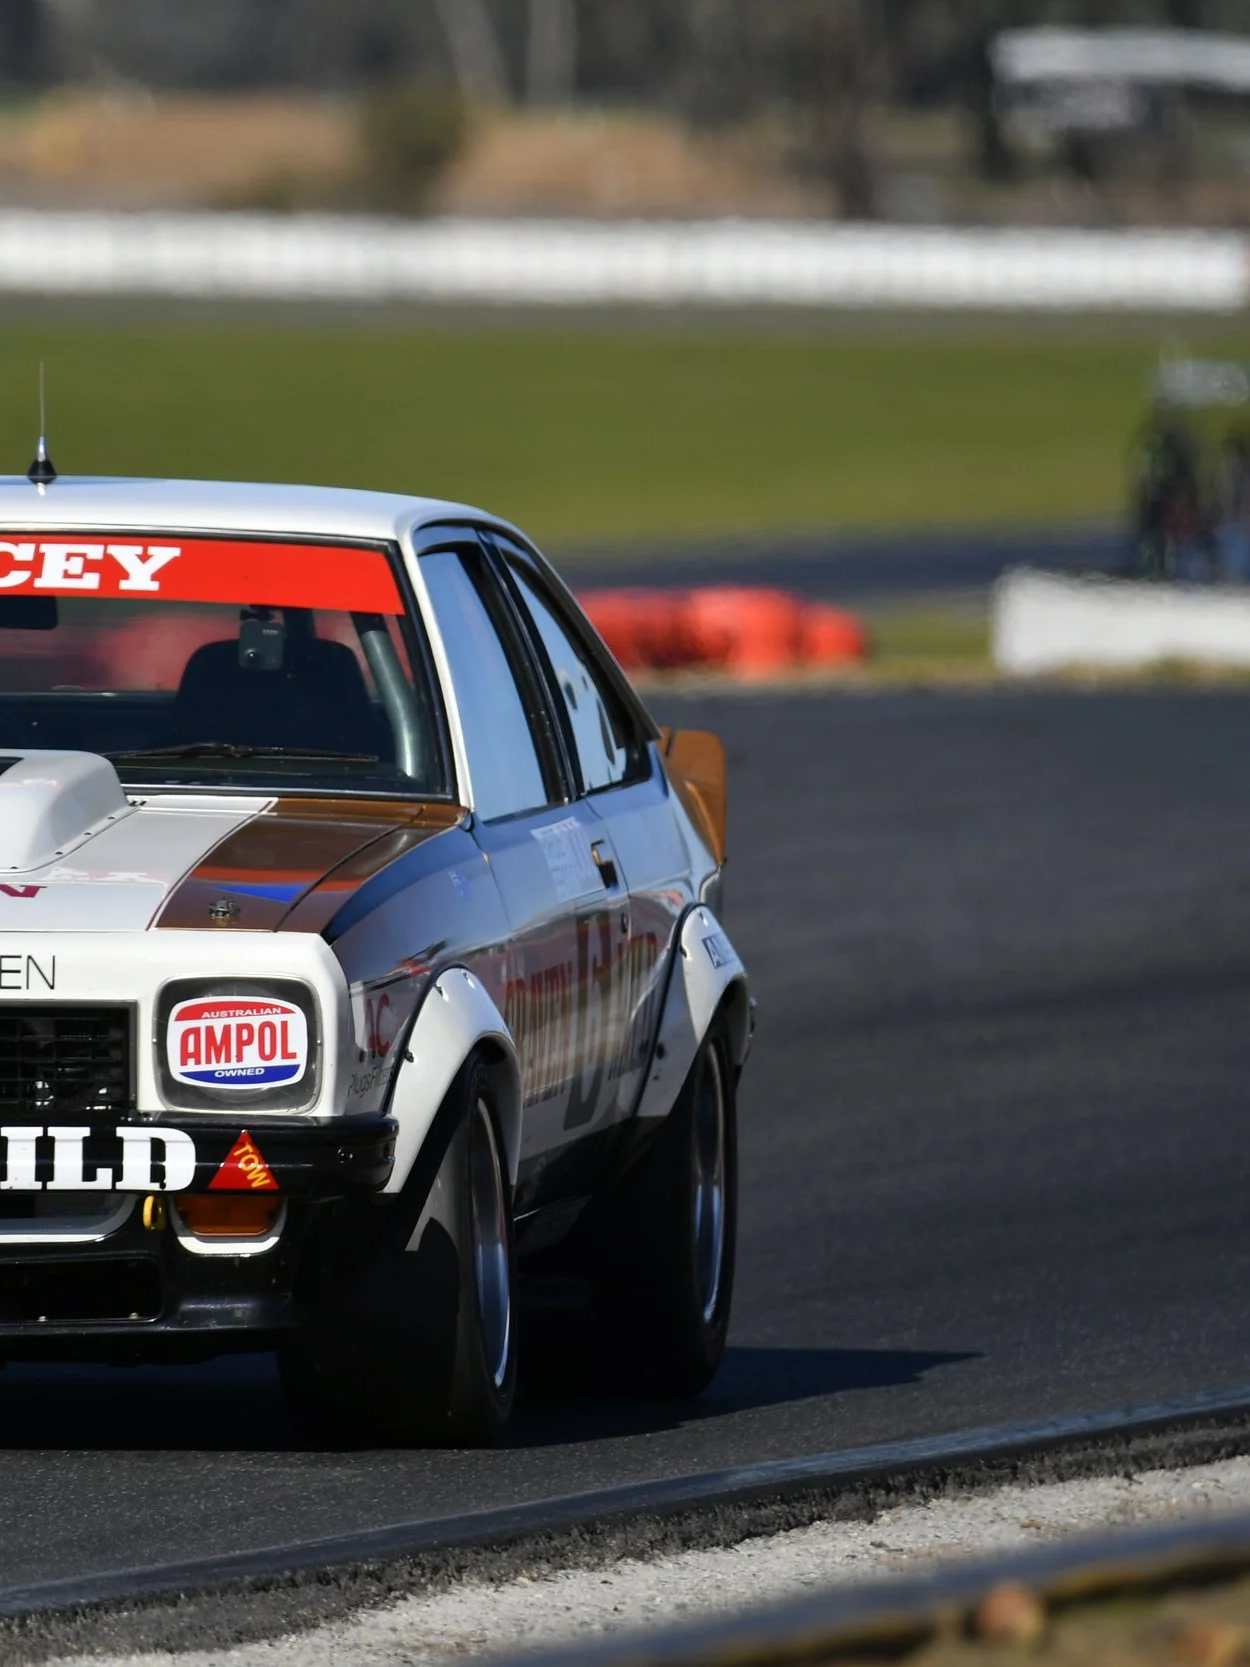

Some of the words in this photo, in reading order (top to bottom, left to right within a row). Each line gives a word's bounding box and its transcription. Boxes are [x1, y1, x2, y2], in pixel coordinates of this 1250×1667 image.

[201, 1007, 282, 1019] AUSTRALIAN
[179, 1020, 298, 1067] AMPOL
[214, 1068, 265, 1078] OWNED
[232, 1142, 271, 1188] TOW
